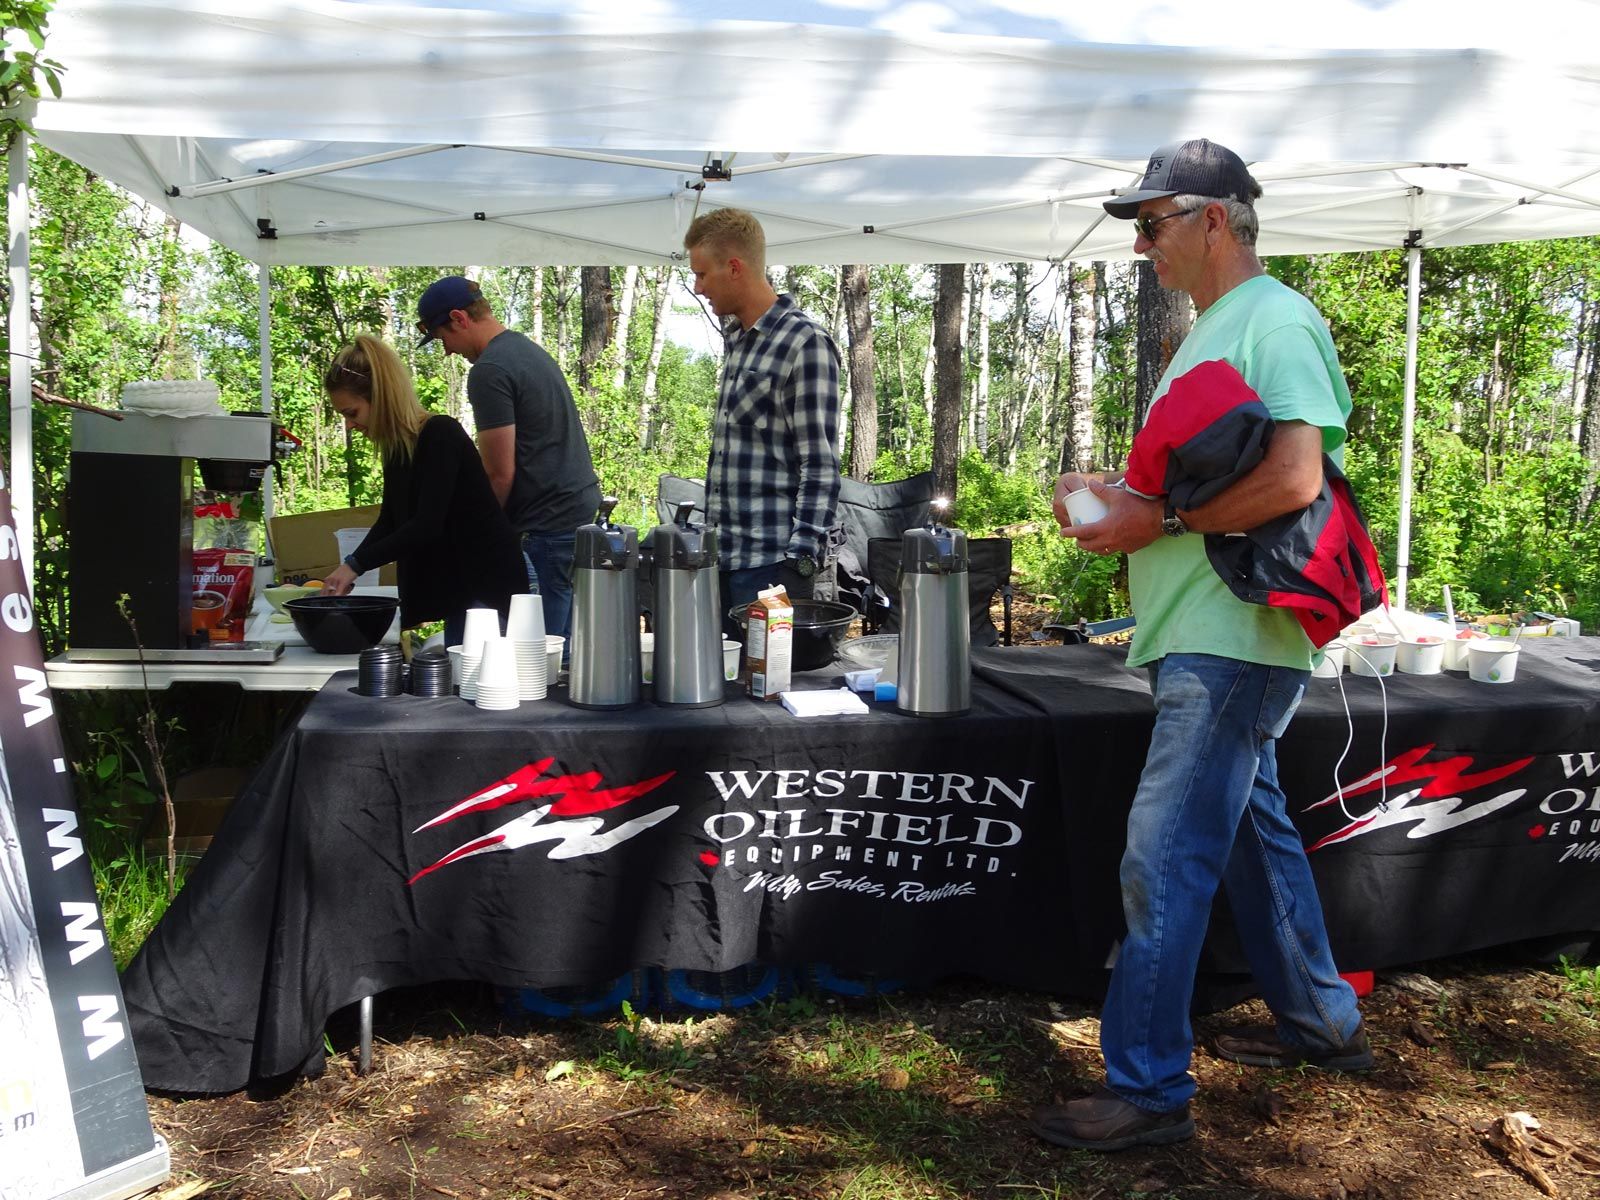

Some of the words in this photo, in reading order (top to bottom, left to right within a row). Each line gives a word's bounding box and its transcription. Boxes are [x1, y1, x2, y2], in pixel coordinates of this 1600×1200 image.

[704, 769, 1036, 809] WESTERN
[703, 808, 1023, 848] OILFIELD
[724, 844, 923, 871] EQUIPMENT
[946, 852, 1017, 877] LTD.
[743, 871, 802, 900] Mfg,
[806, 870, 887, 898] Sales,
[891, 881, 977, 902] Rentals
